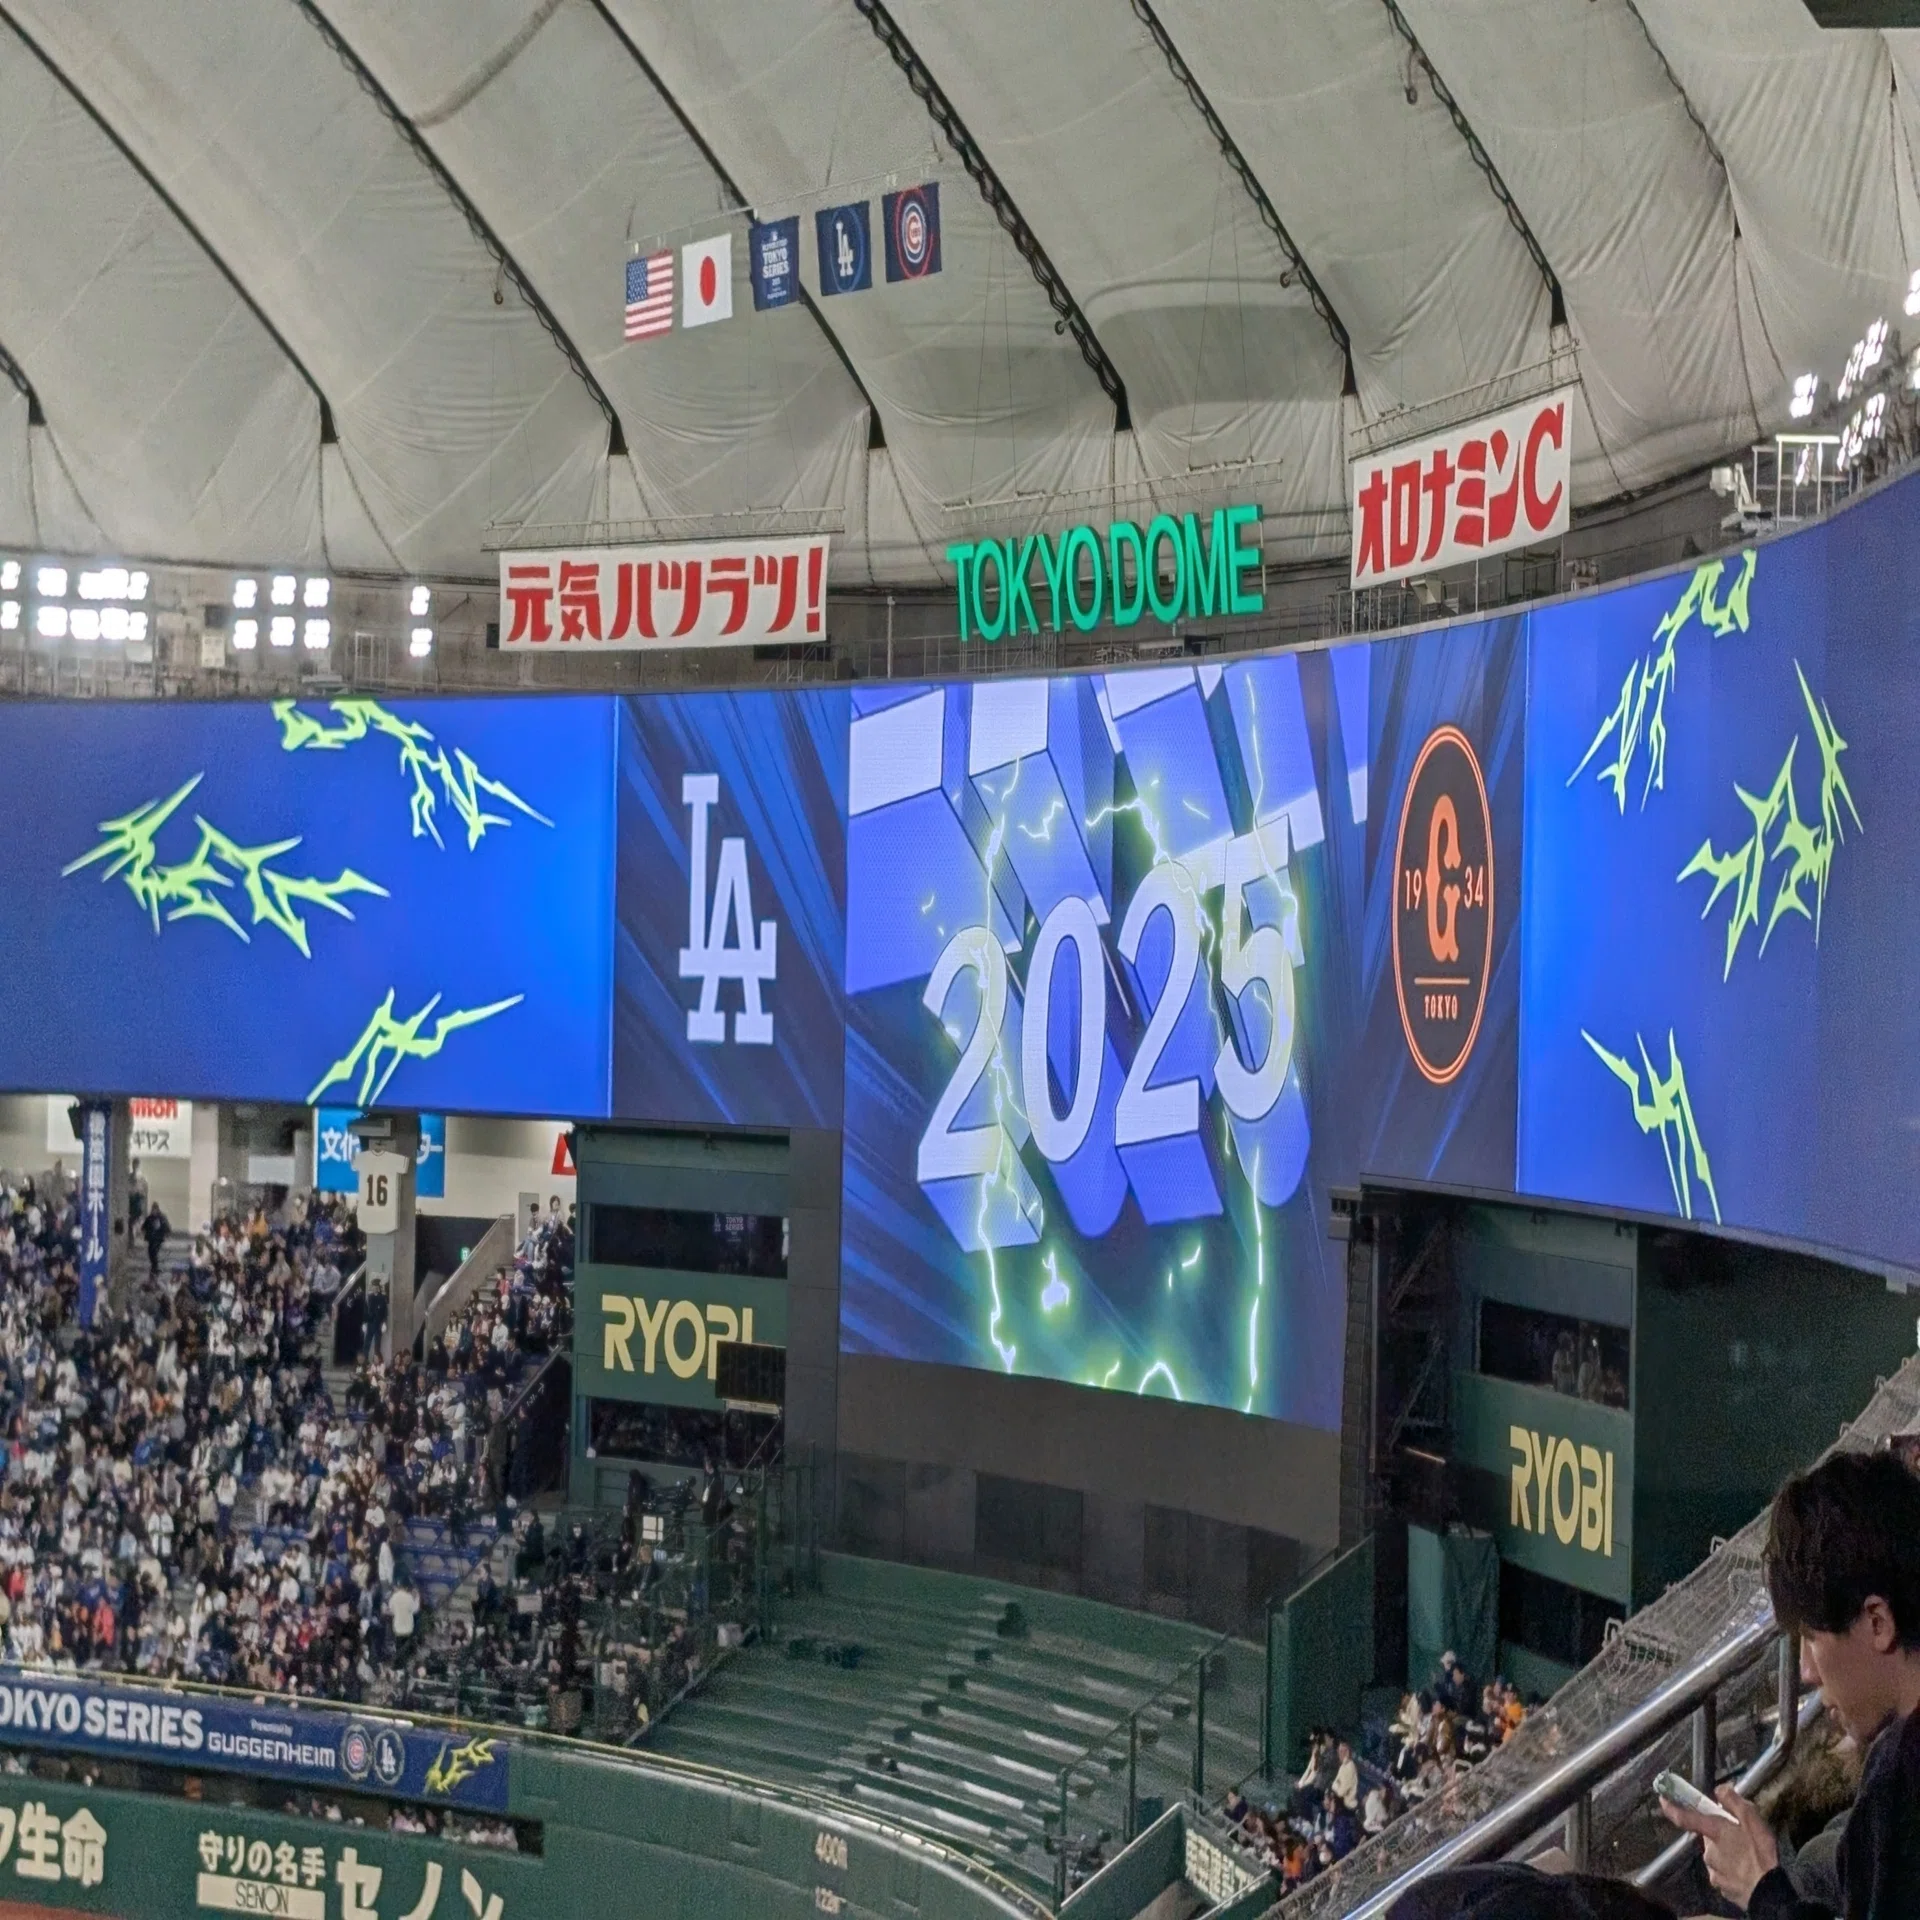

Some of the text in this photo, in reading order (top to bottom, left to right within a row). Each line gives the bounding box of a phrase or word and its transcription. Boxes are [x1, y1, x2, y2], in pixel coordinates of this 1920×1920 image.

[762, 261, 789, 279] SERIES
[763, 247, 788, 266] TOKYO
[836, 221, 853, 276] LA
[1356, 402, 1564, 578] オロナミンC
[506, 547, 823, 642] 元気ハツラツ!
[946, 504, 1264, 642] TOKYO DOME
[1405, 793, 1484, 962] 19 G 34
[679, 773, 777, 1044] LA
[917, 814, 1295, 1182] 2025
[1424, 995, 1458, 1020] TOKYO
[366, 1174, 388, 1206] 16
[1510, 1425, 1613, 1557] RYOBI
[83, 1696, 203, 1749] SERIES
[208, 1731, 335, 1769] GUGGENHEIM
[198, 1829, 326, 1887] 守りの名手
[236, 1882, 289, 1914] SENON
